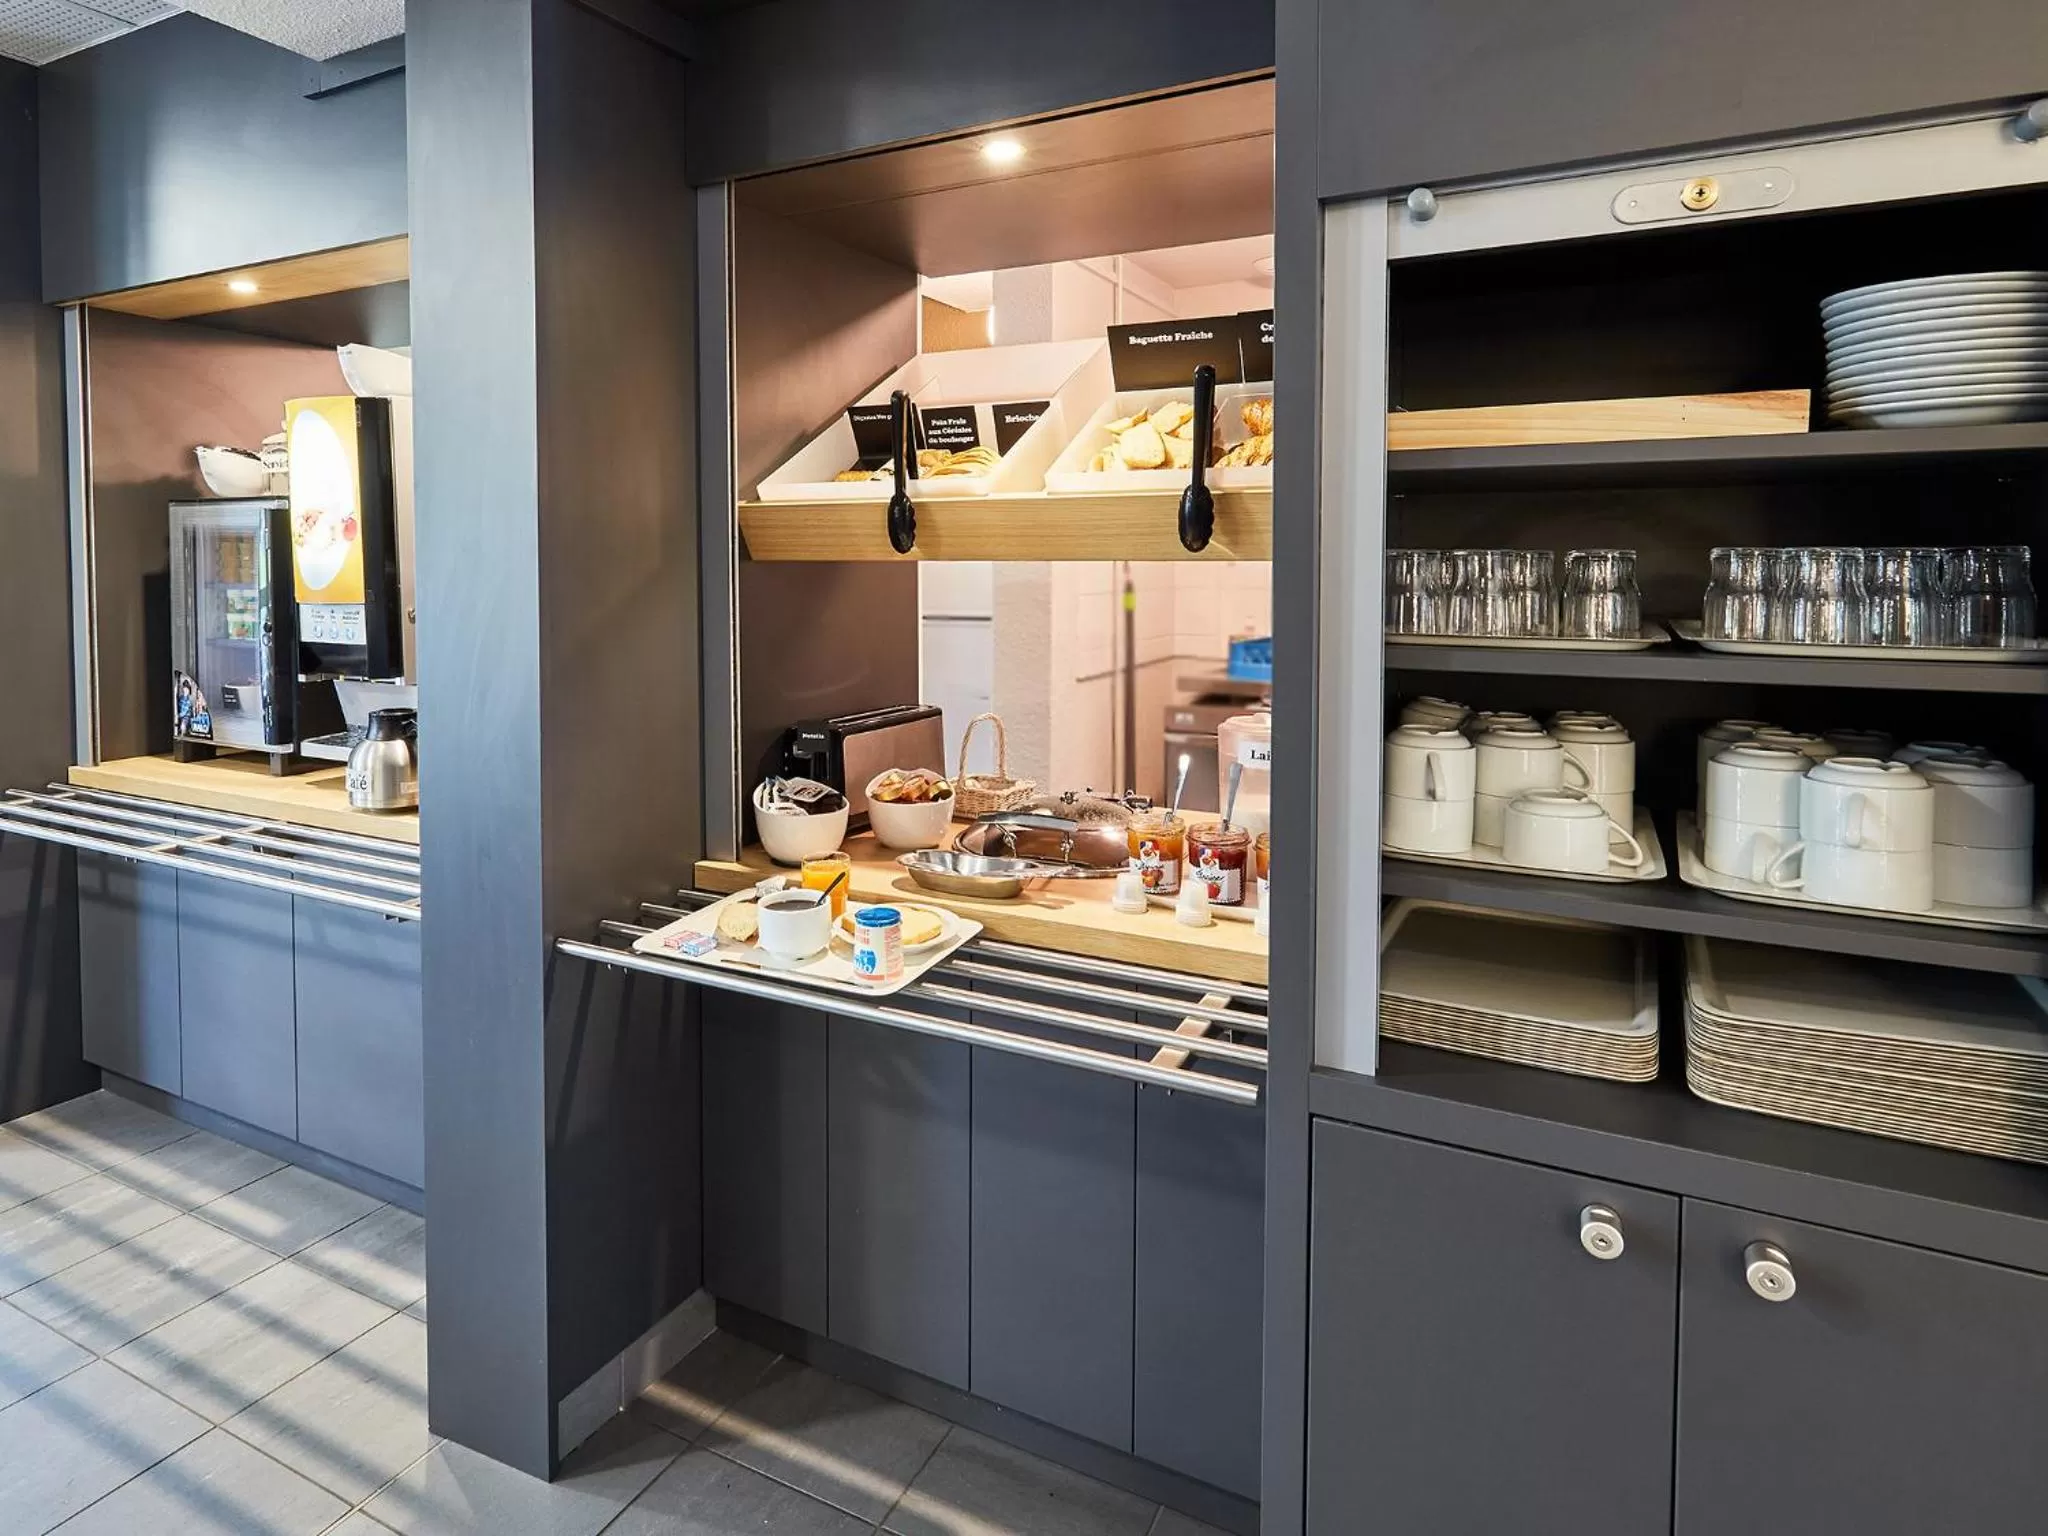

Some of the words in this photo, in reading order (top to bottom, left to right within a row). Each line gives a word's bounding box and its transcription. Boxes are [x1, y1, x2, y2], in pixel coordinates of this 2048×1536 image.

[1128, 333, 1173, 345] Baguette
[1250, 749, 1271, 761] Lai
[347, 773, 368, 790] afé
